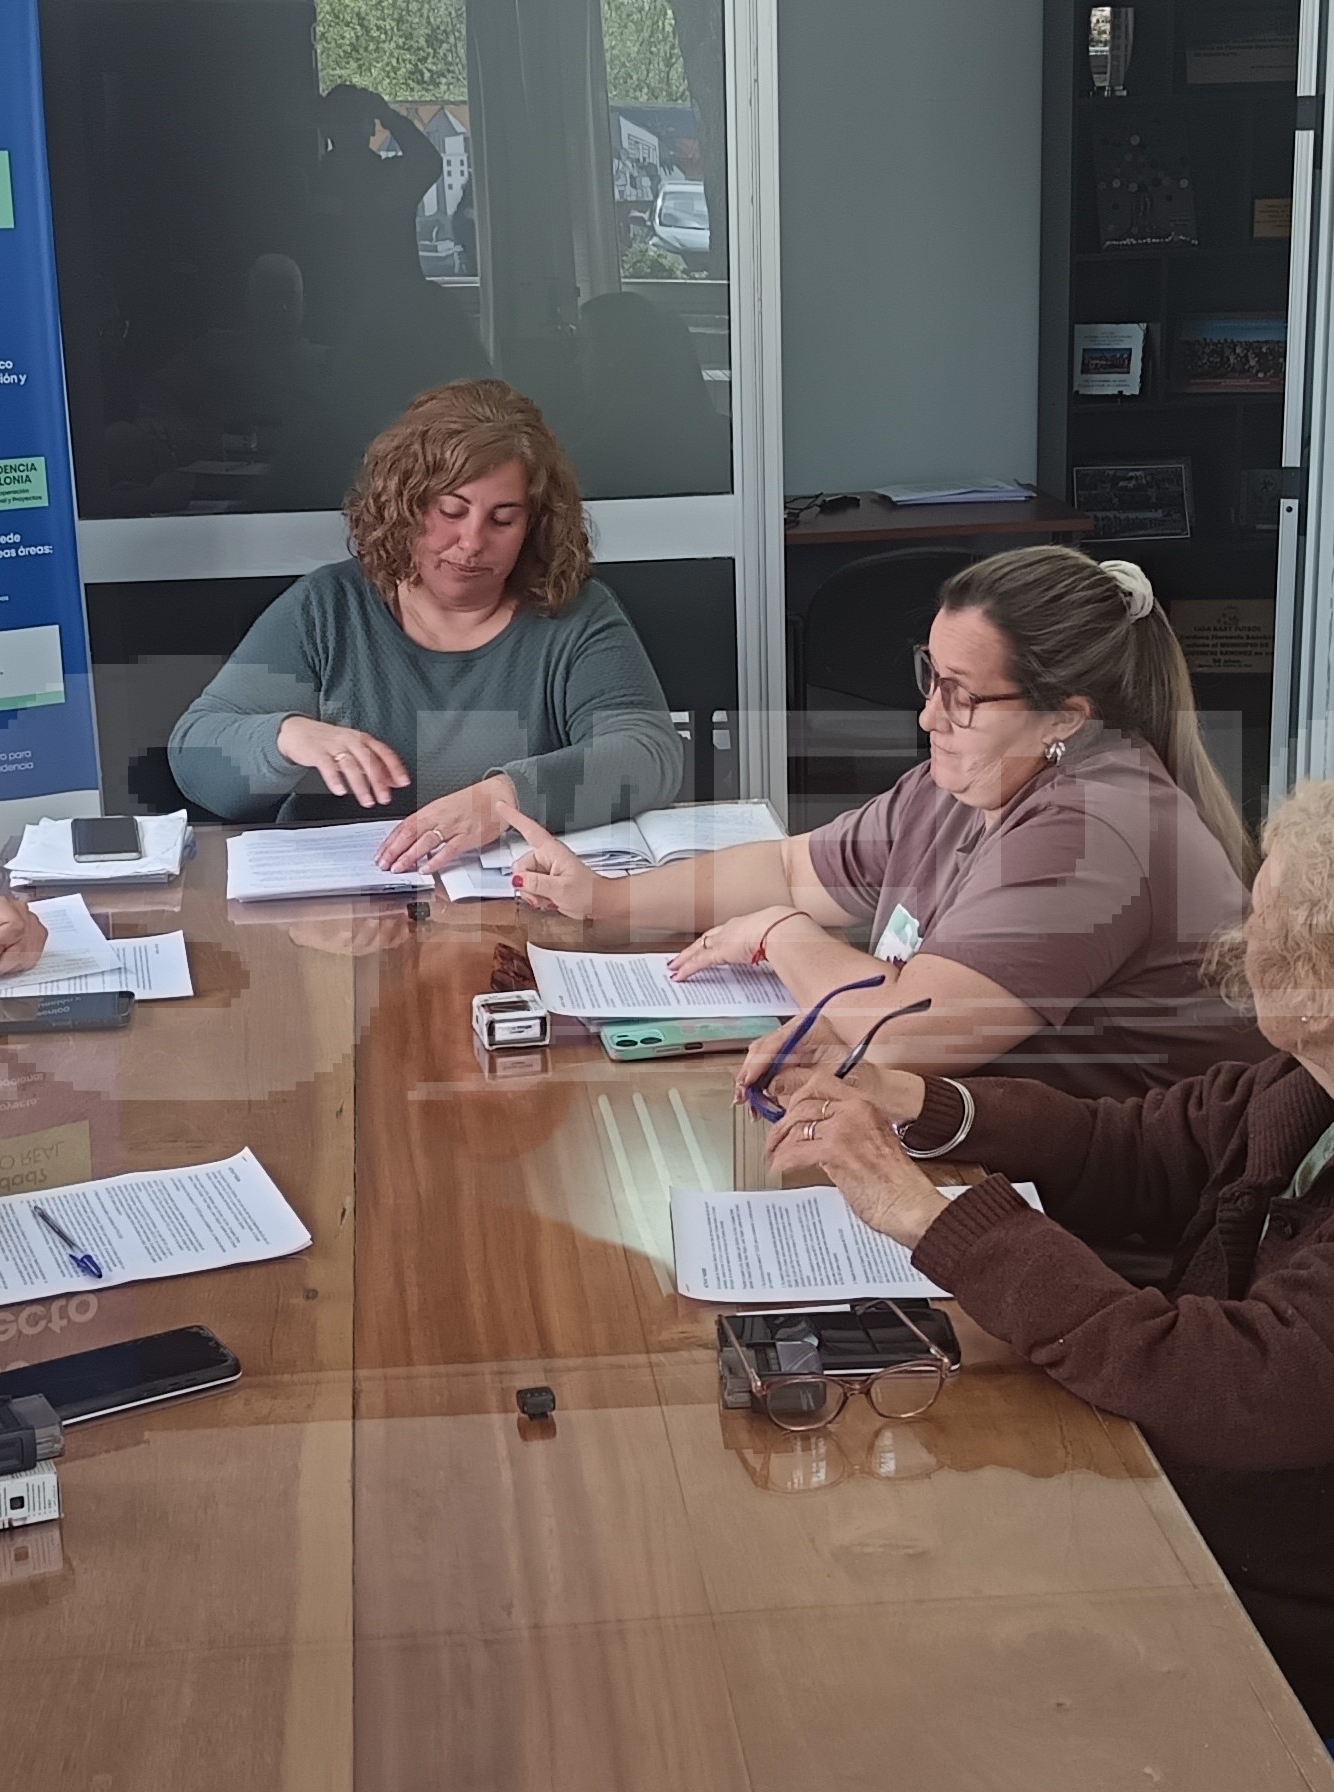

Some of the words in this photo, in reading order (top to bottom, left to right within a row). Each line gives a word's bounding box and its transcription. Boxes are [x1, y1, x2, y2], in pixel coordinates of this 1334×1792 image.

[18, 374, 27, 386] y
[18, 545, 54, 557] áreas:
[9, 750, 32, 764] para
